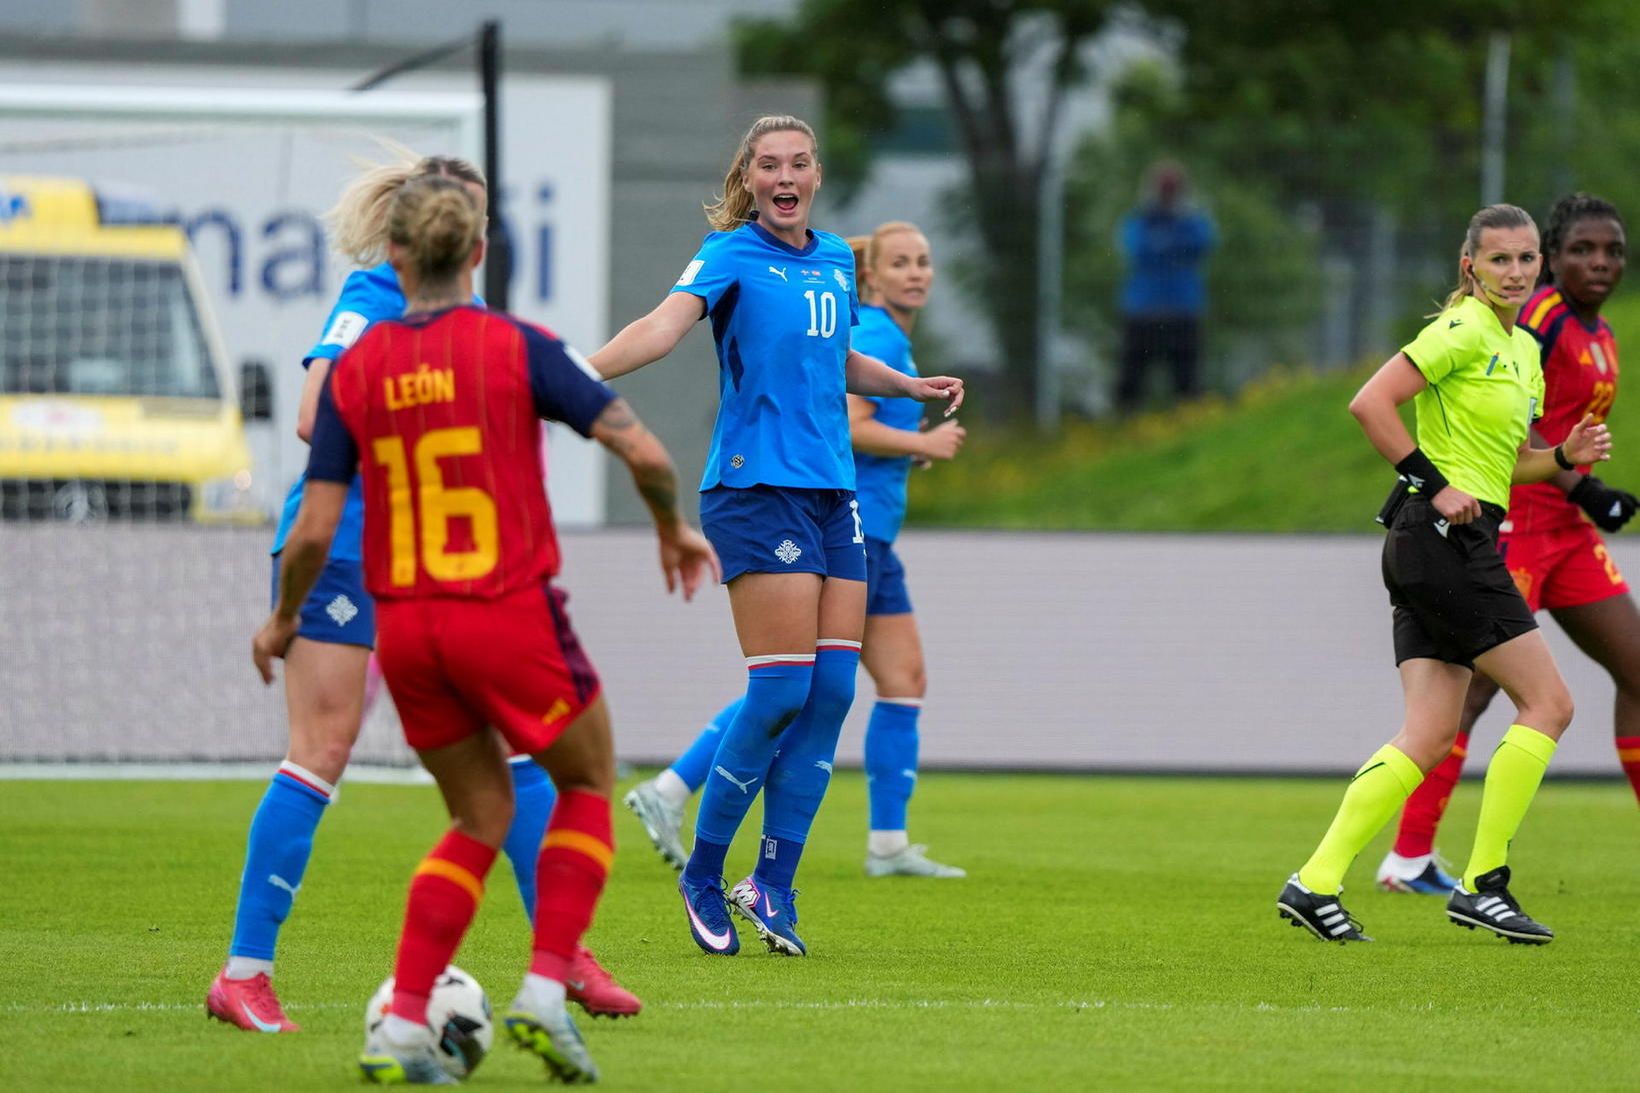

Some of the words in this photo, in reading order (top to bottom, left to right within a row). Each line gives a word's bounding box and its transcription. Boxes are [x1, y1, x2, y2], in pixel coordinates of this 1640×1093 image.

[803, 290, 837, 339] 10
[384, 364, 455, 411] LEÓN
[372, 426, 498, 587] 16
[849, 500, 865, 544] 1
